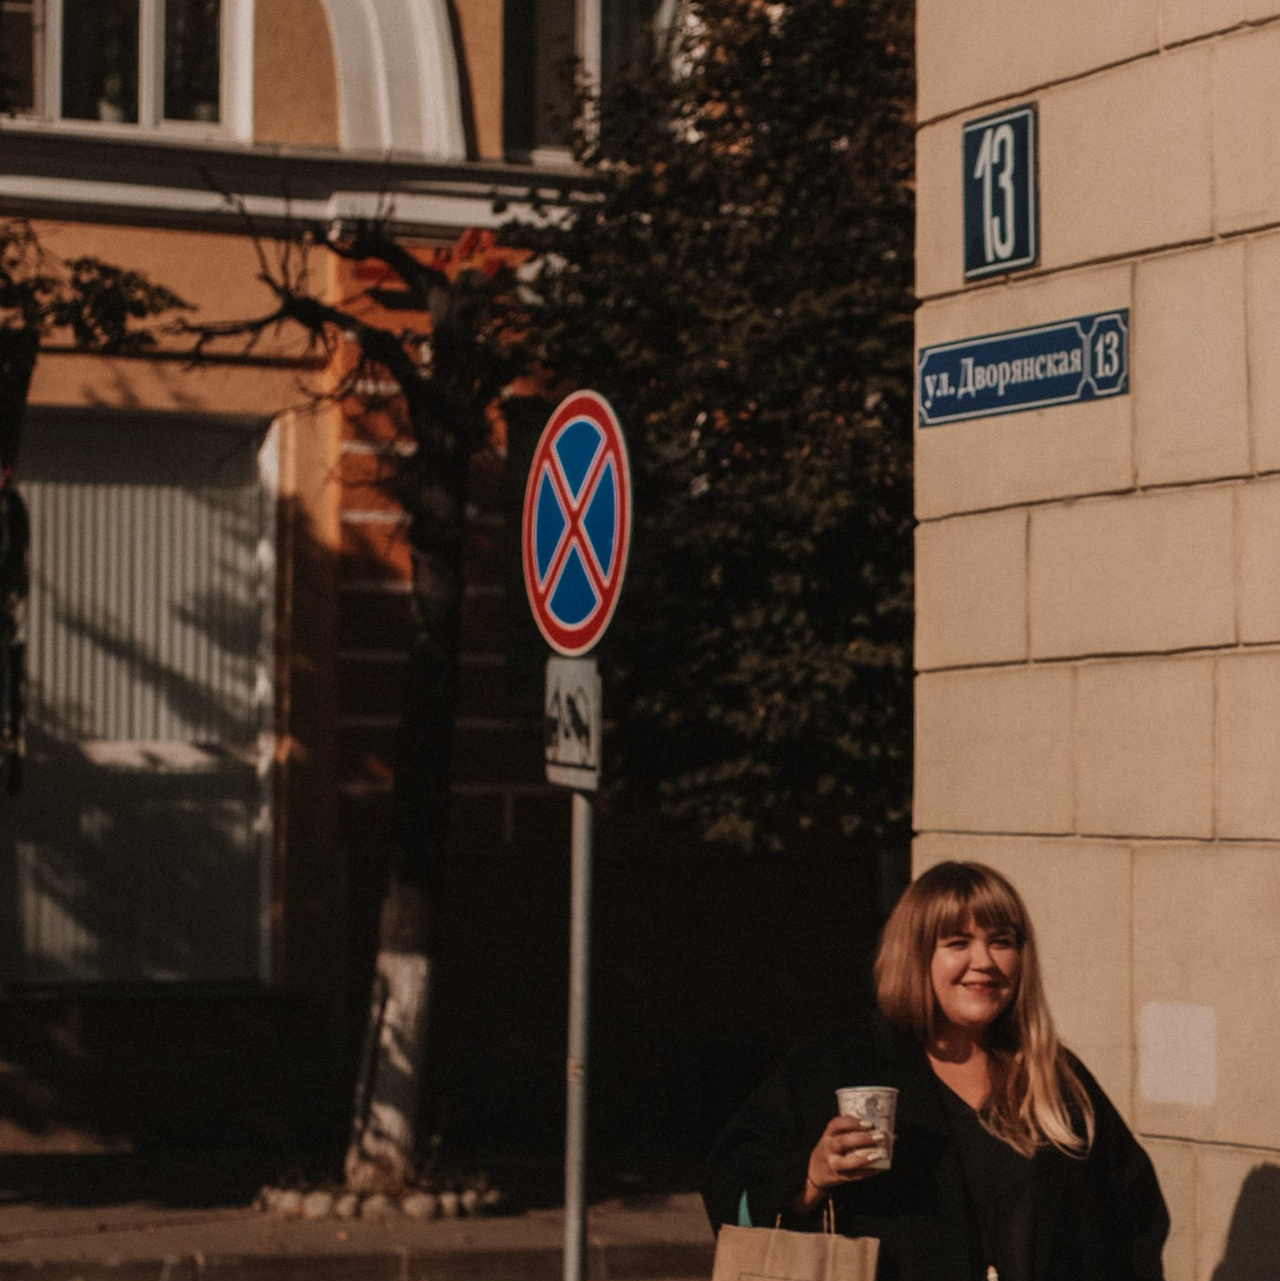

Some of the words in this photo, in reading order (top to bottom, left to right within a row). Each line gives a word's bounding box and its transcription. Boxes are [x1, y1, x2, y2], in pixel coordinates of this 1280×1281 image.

[974, 124, 1015, 263] 13
[924, 371, 955, 408] ул.
[958, 348, 1082, 397] Дворянская
[1094, 330, 1120, 379] 13
